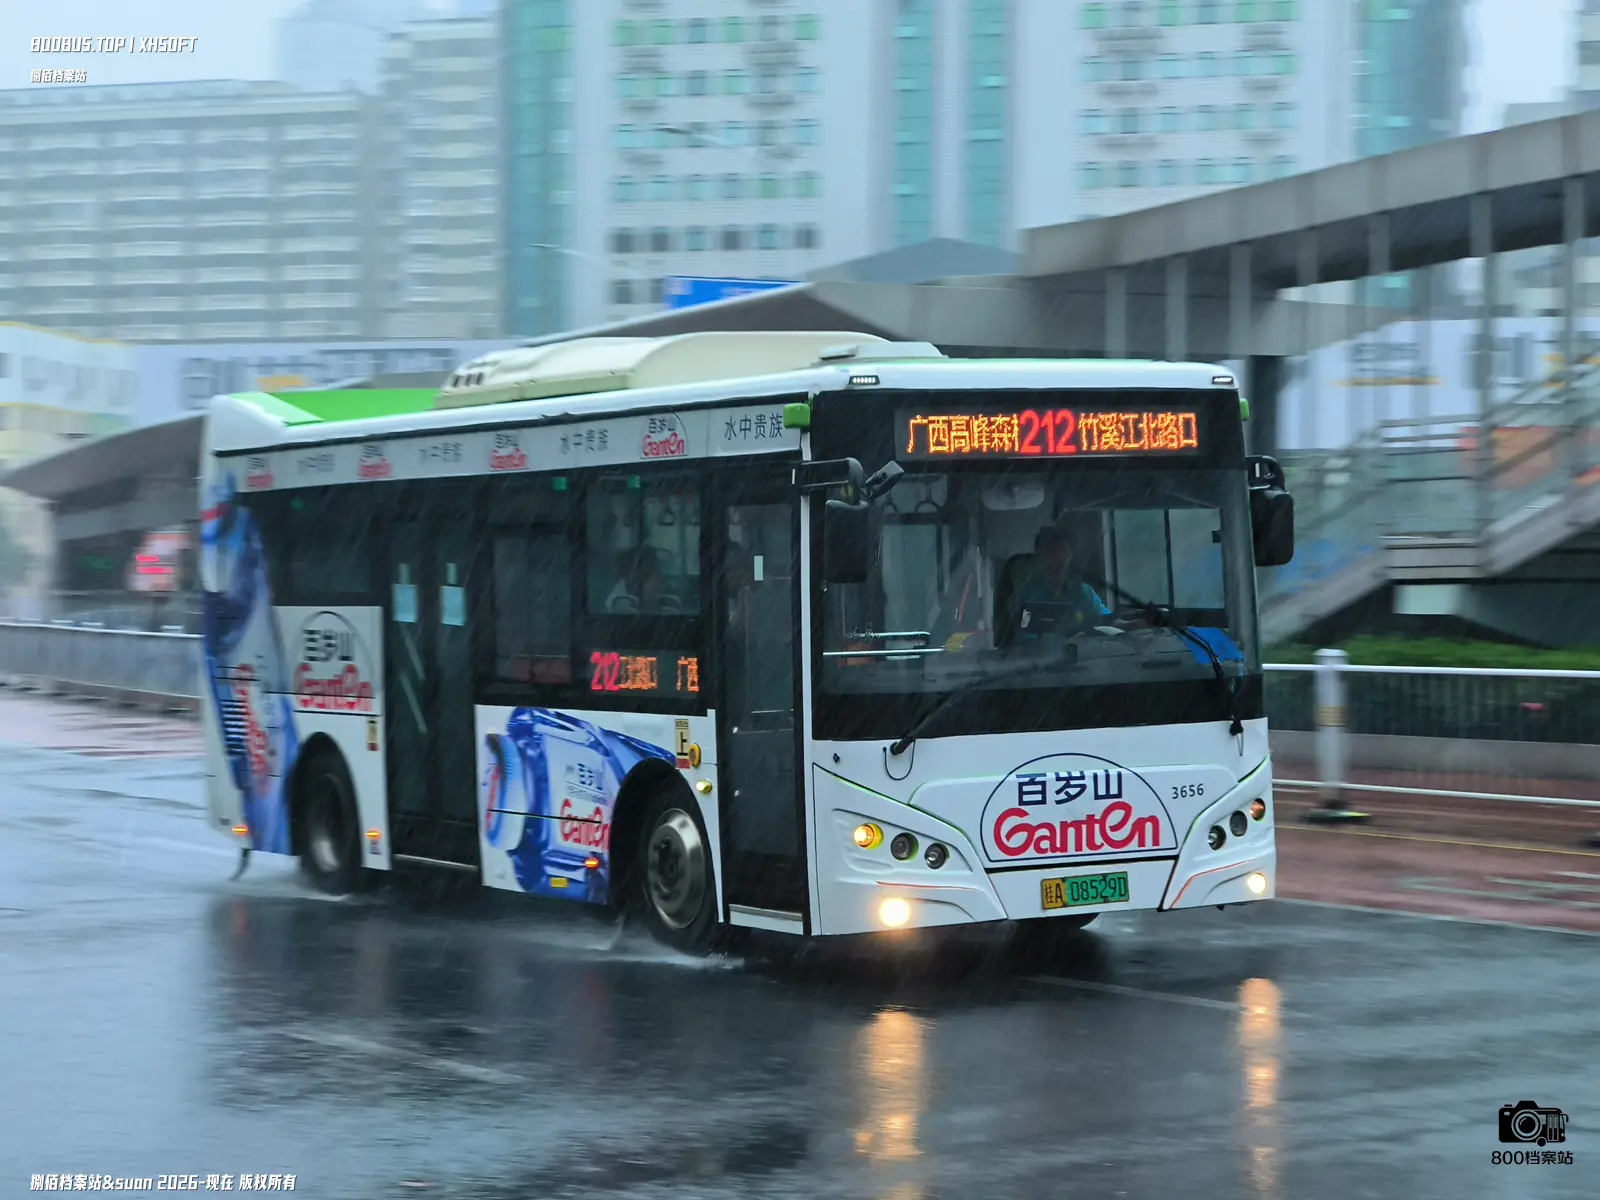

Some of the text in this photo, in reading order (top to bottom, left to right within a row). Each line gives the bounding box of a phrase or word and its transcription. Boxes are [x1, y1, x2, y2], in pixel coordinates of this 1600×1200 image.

[724, 413, 783, 441] 水中贵族
[1019, 408, 1077, 455] 212
[1078, 411, 1199, 452] 竹溪江北路口
[1015, 769, 1123, 807] 百岁山
[1171, 783, 1205, 800] 3656
